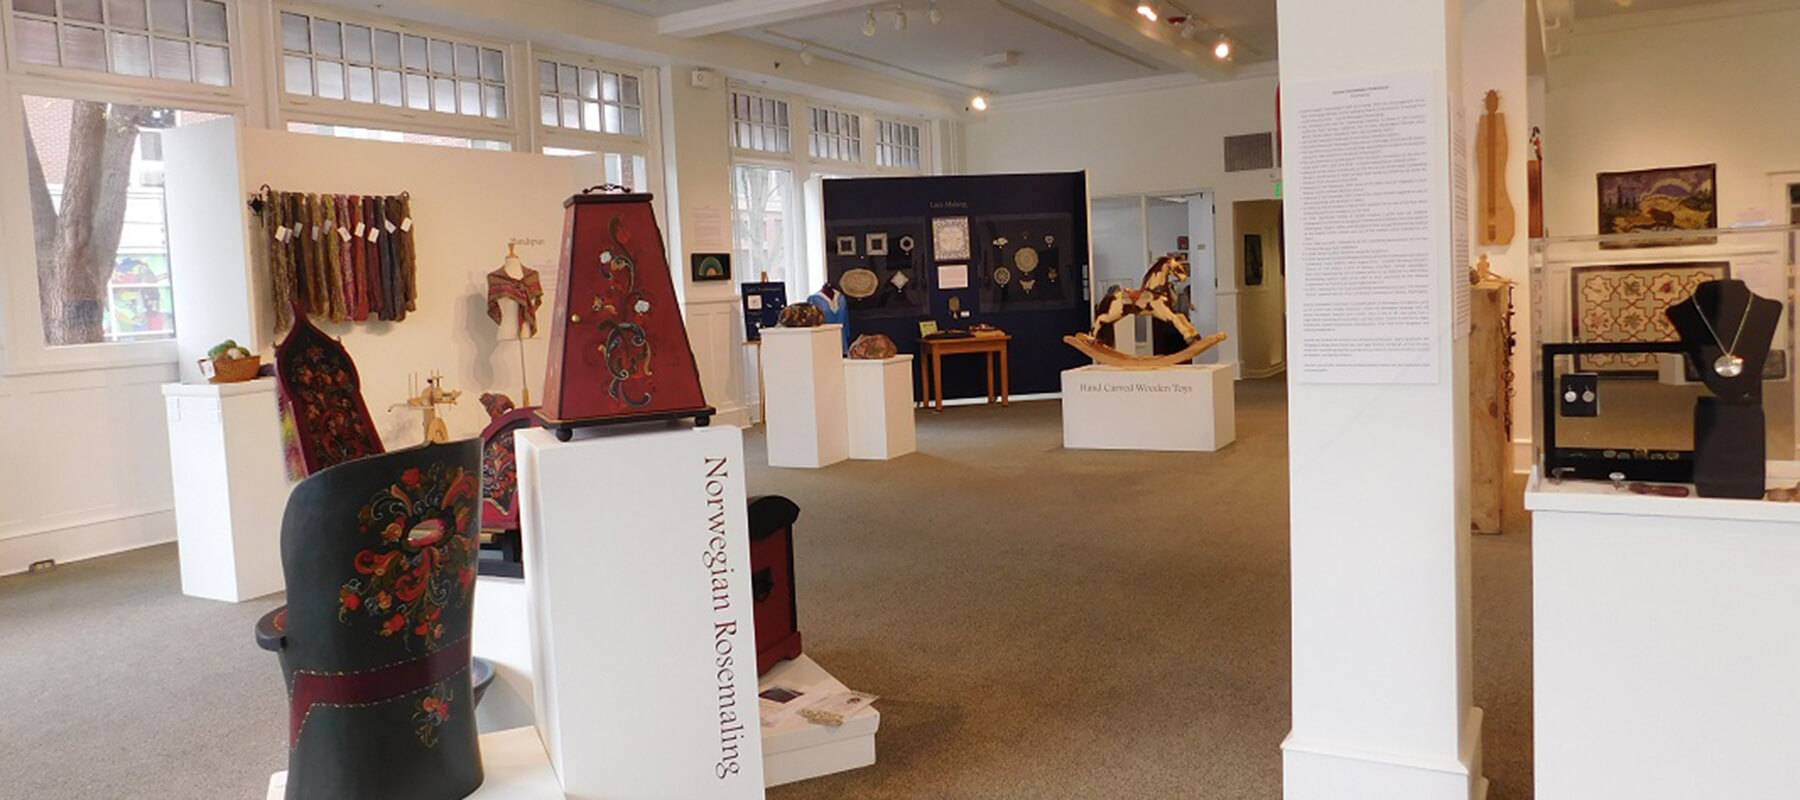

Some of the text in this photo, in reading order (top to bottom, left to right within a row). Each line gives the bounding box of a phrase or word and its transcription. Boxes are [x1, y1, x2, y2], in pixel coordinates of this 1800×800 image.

[1080, 383, 1193, 394] Hand Carved Wooden Toys
[702, 457, 745, 779] Norwegian Rosemaling
